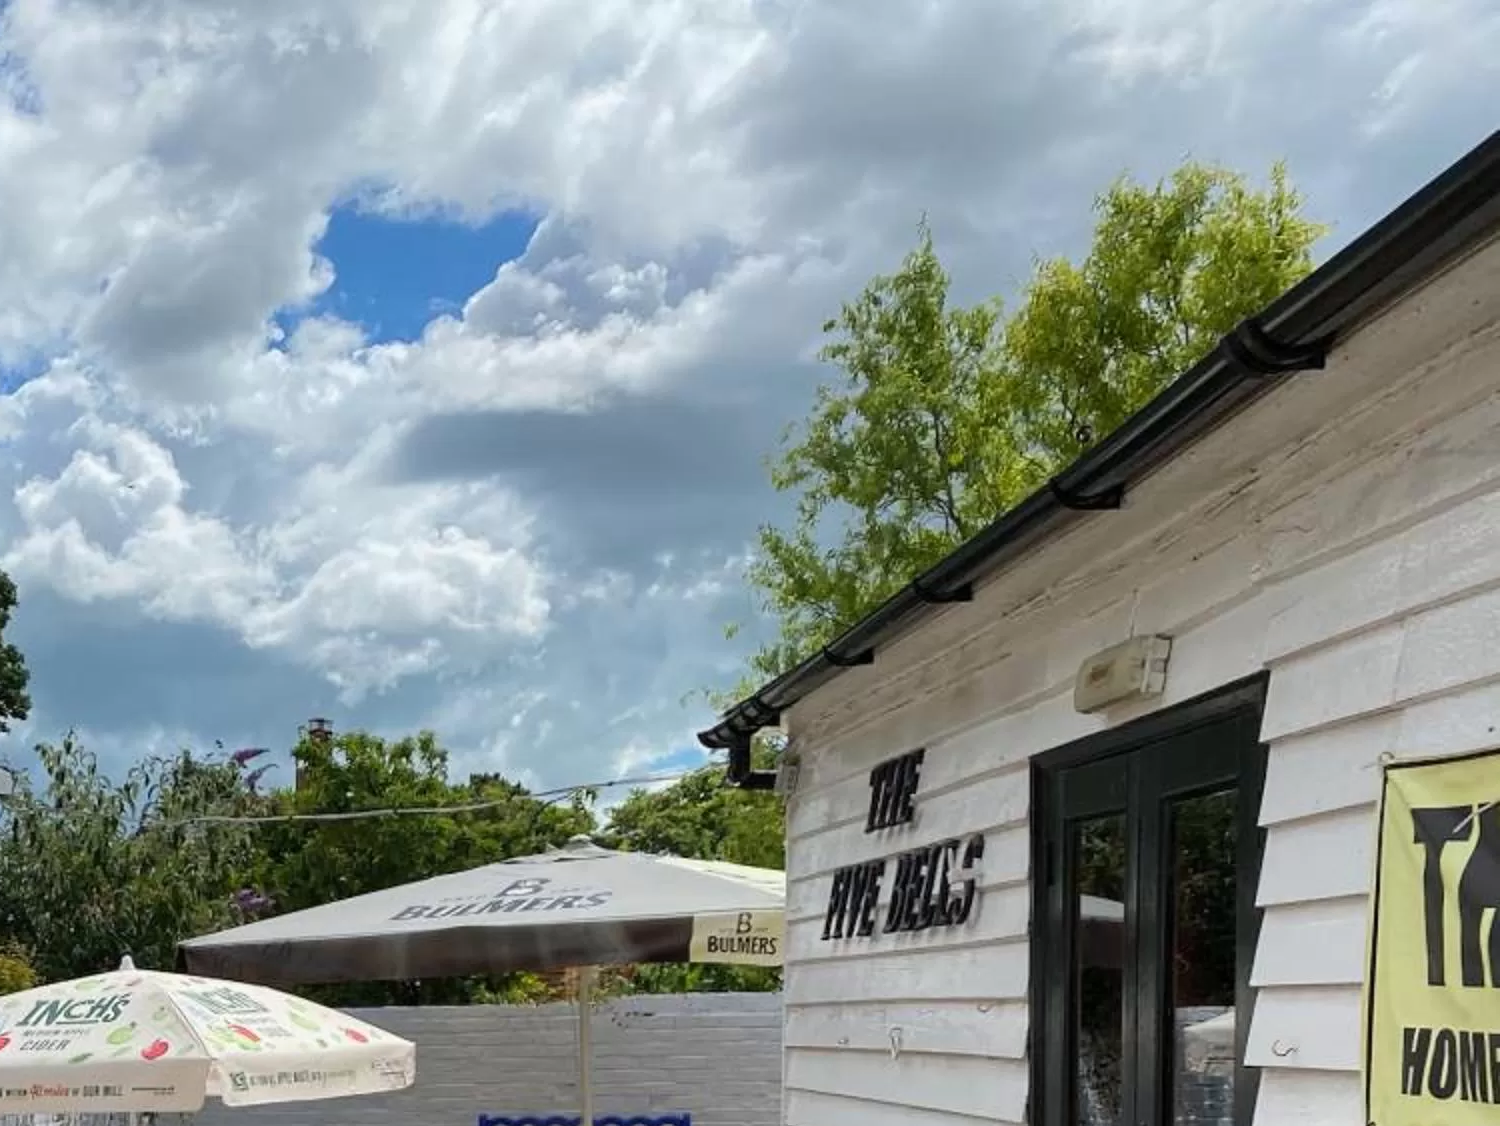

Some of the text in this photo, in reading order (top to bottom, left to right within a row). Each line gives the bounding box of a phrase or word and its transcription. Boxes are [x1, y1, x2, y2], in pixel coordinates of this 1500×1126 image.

[865, 748, 926, 833] THE
[821, 833, 985, 941] FIVE BELLS
[389, 891, 612, 920] BULMERS
[736, 912, 752, 934] B
[707, 935, 779, 955] BULMERS
[20, 1038, 71, 1051] CIDER
